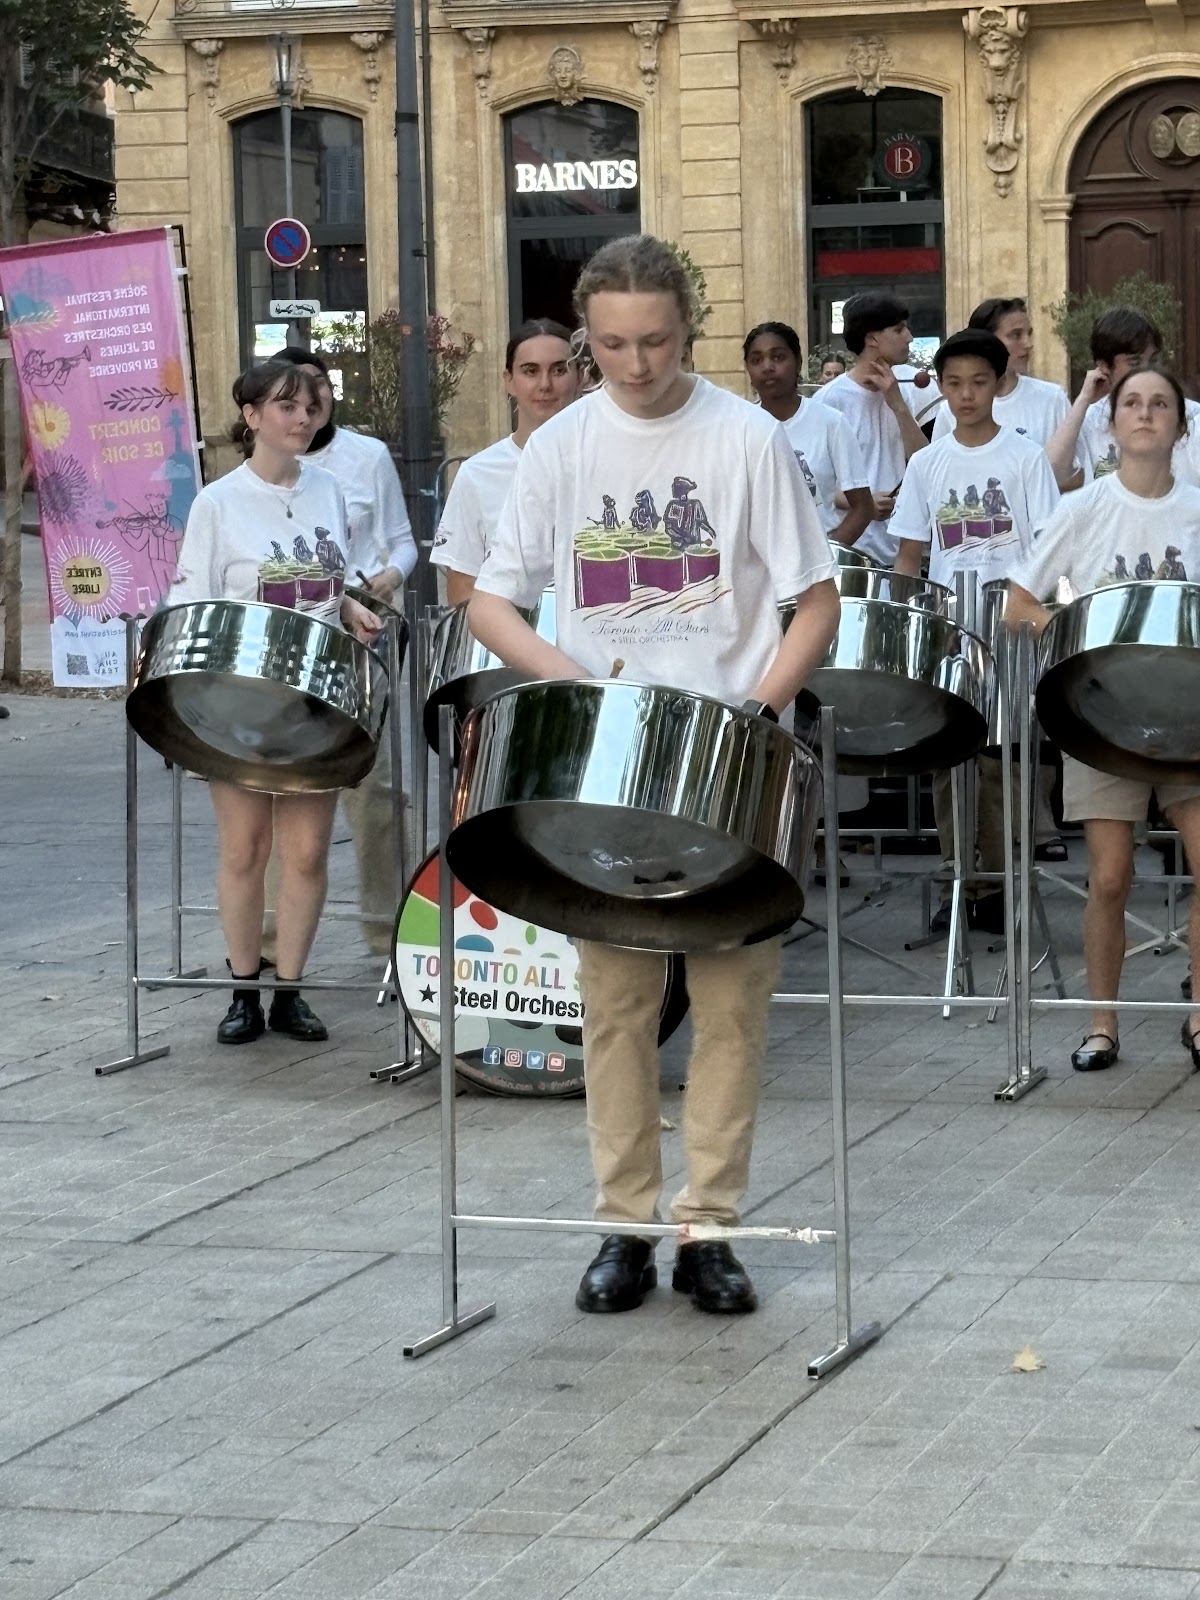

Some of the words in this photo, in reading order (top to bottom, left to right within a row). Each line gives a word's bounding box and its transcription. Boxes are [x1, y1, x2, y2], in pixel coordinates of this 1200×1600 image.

[894, 147, 914, 174] B
[515, 159, 638, 193] BARNES
[592, 619, 641, 635] Toronto
[644, 617, 674, 634] All
[676, 619, 710, 634] Stars
[639, 635, 684, 644] ORCHESTRA
[412, 953, 518, 985] TOONTO
[523, 965, 567, 990] ALL
